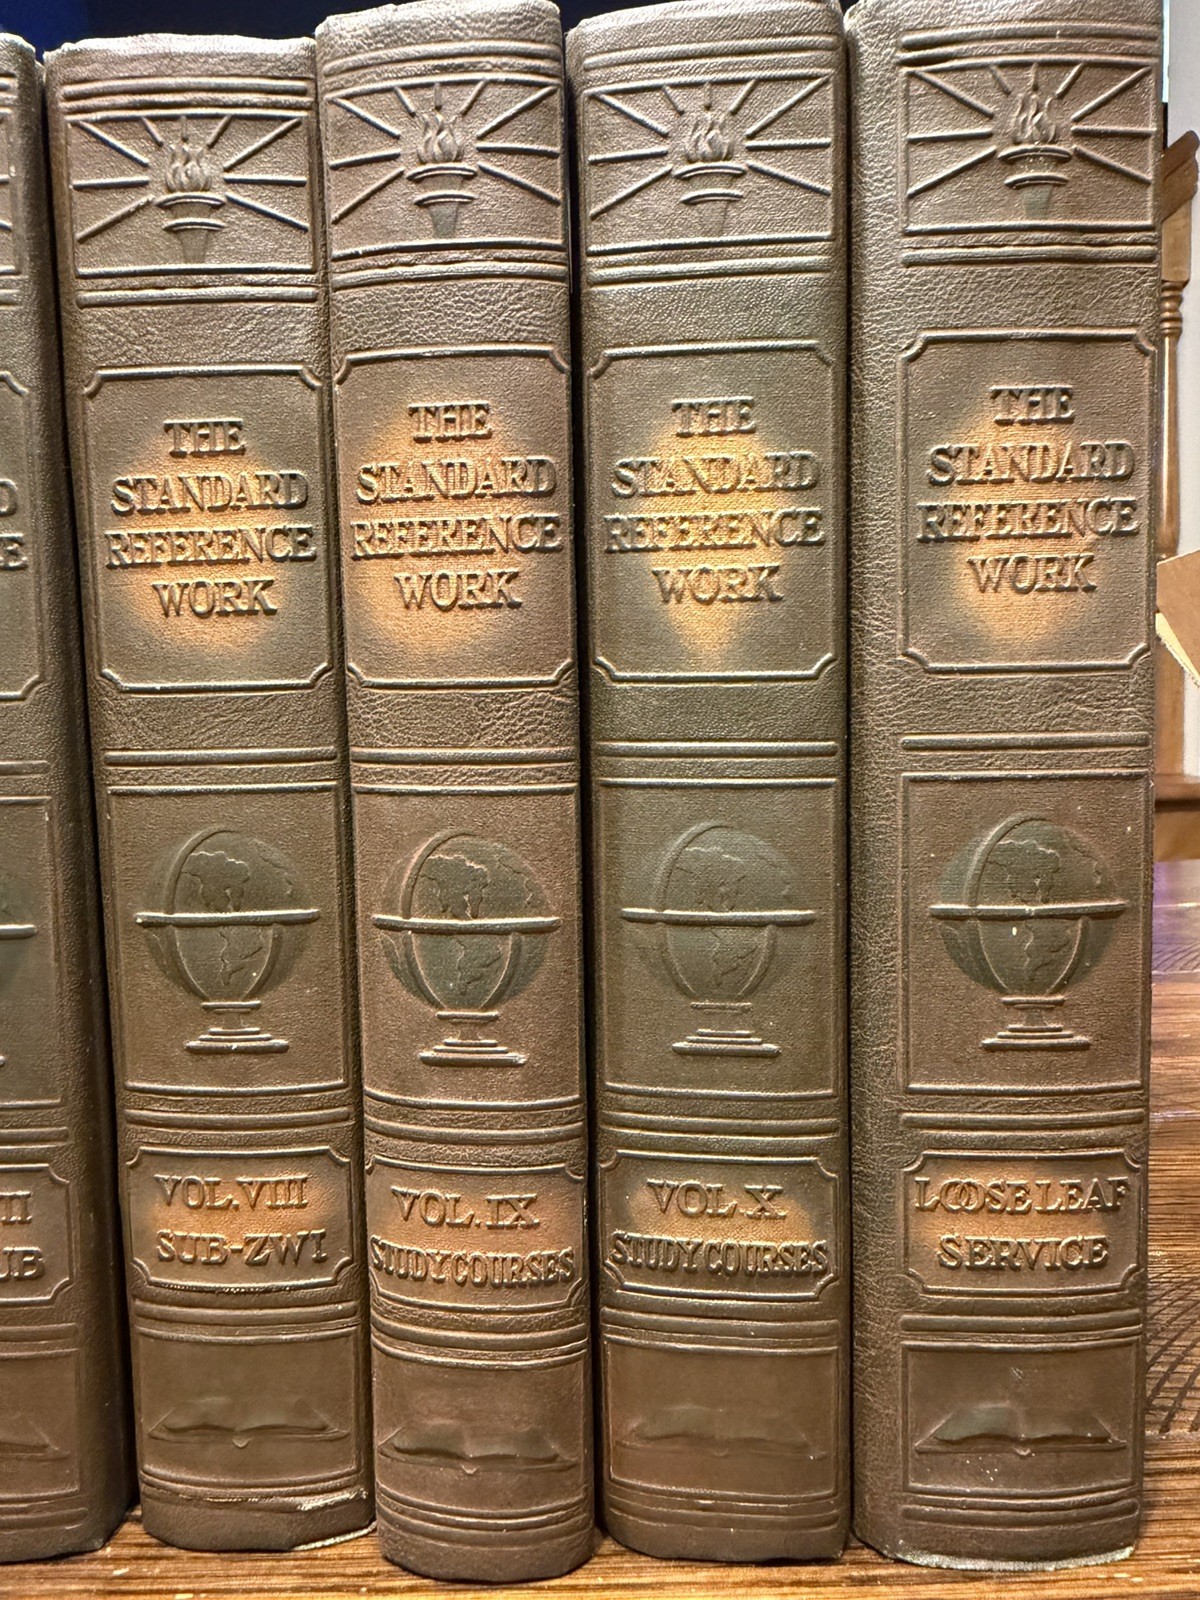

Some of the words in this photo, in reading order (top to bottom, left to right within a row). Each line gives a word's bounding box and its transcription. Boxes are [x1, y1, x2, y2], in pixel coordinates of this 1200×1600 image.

[408, 400, 493, 443] THE
[670, 396, 756, 438] THE
[989, 384, 1075, 425] THE
[163, 417, 247, 457] THE
[356, 455, 557, 505] STANDARD
[611, 451, 821, 498] STANDARD
[926, 440, 1136, 486] STANDARD
[110, 469, 309, 516] STANDARD
[351, 513, 563, 561] REFERENCE
[603, 506, 826, 554] REFERENCE
[916, 497, 1141, 544] REFERENCE
[104, 524, 317, 569] REFERENCE
[393, 568, 523, 612] WORK
[651, 562, 785, 605] WORK
[966, 552, 1098, 594] WORK
[152, 576, 278, 619] WORK
[914, 1176, 1033, 1216] LOOSE
[1035, 1176, 1130, 1213] LEAF
[155, 1228, 329, 1268] SUB-ZWI
[937, 1232, 1110, 1271] SERVICE
